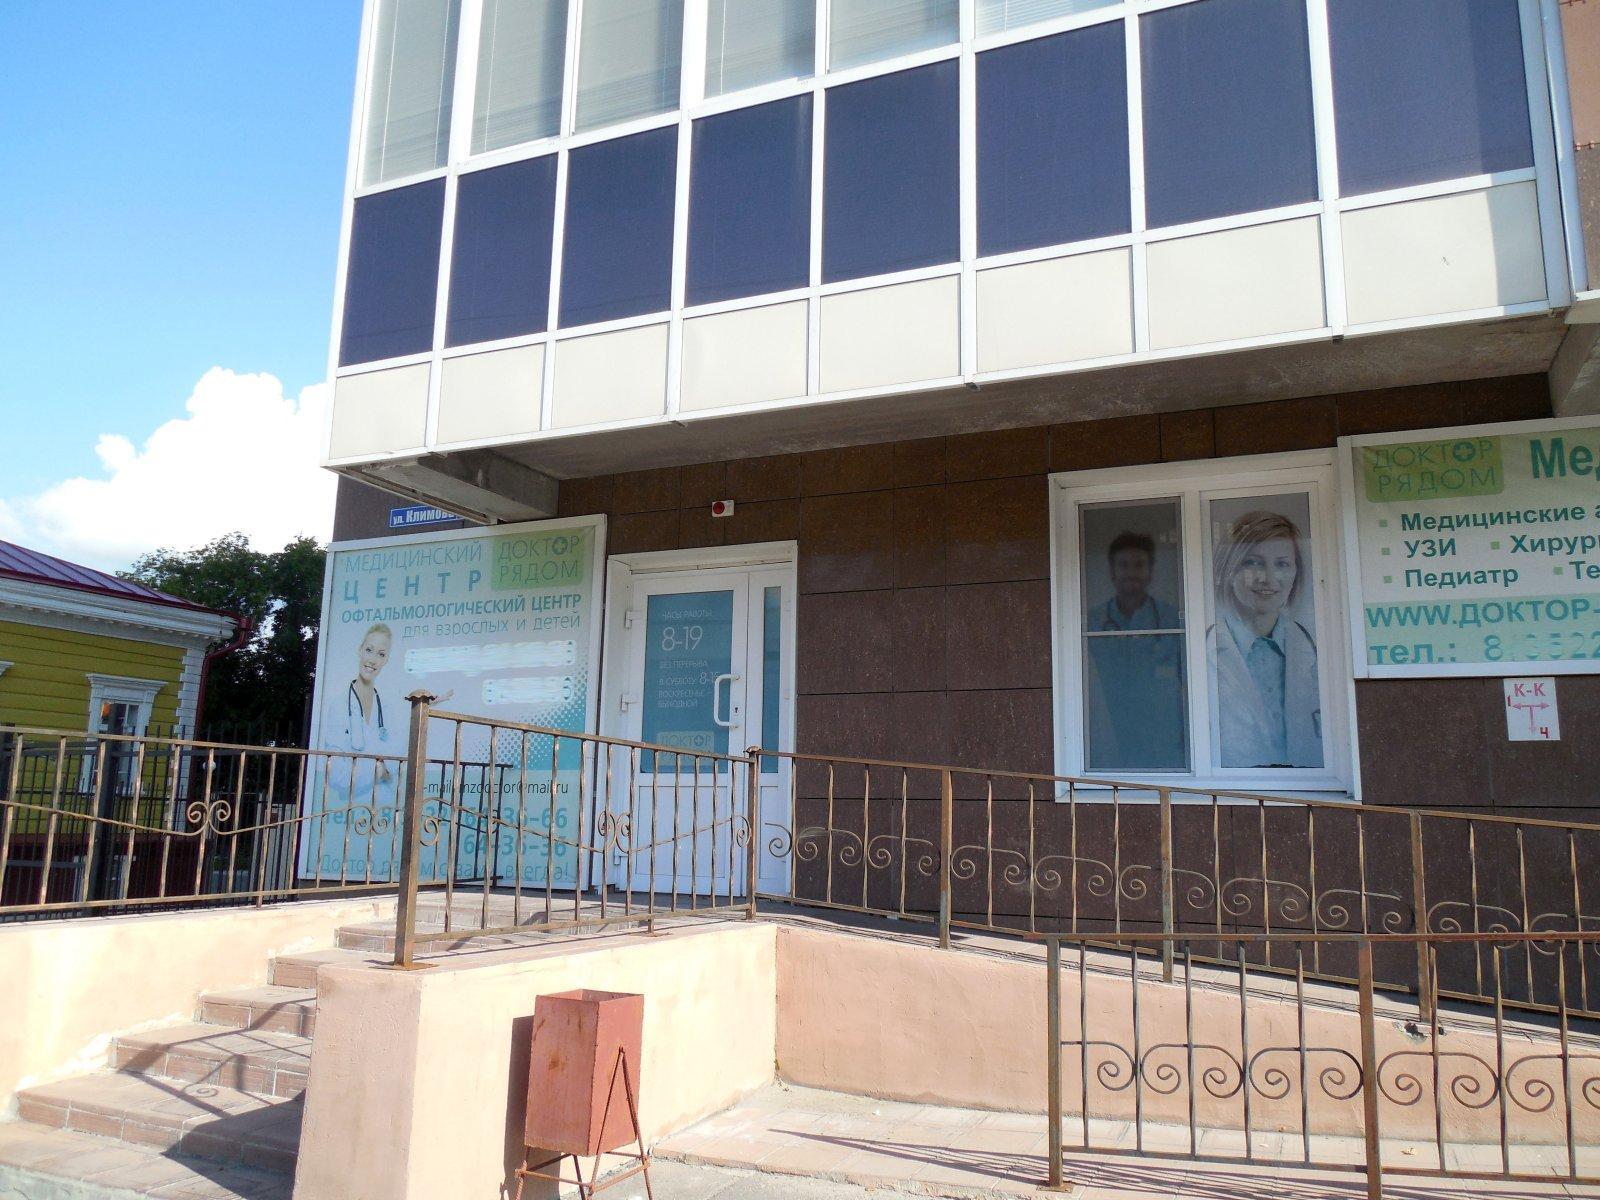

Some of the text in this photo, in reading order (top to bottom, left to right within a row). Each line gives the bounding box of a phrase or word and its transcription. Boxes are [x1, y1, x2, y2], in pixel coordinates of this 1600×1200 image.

[1373, 438, 1494, 471] ДОКТОР
[1530, 436, 1600, 482] Ме
[1378, 467, 1496, 494] РЯДОМ
[393, 515, 405, 525] ул.
[1401, 504, 1586, 531] Медицинские
[345, 540, 482, 573] МЕДИЦИНСКИЙ
[497, 535, 580, 562] ДОКТОР
[1405, 533, 1600, 558] УЗИ Хирур
[500, 560, 578, 584] РЯДОМ
[1405, 566, 1519, 589] Педиатр
[343, 569, 482, 604] ЦЕНТР
[341, 593, 582, 624] ОФТАЛЬМОЛОГИЧЕСКИЙ ЦЕНТР
[402, 626, 430, 639] для
[435, 619, 510, 636] взрослых
[533, 612, 581, 631] детей
[662, 625, 703, 651] 8-19
